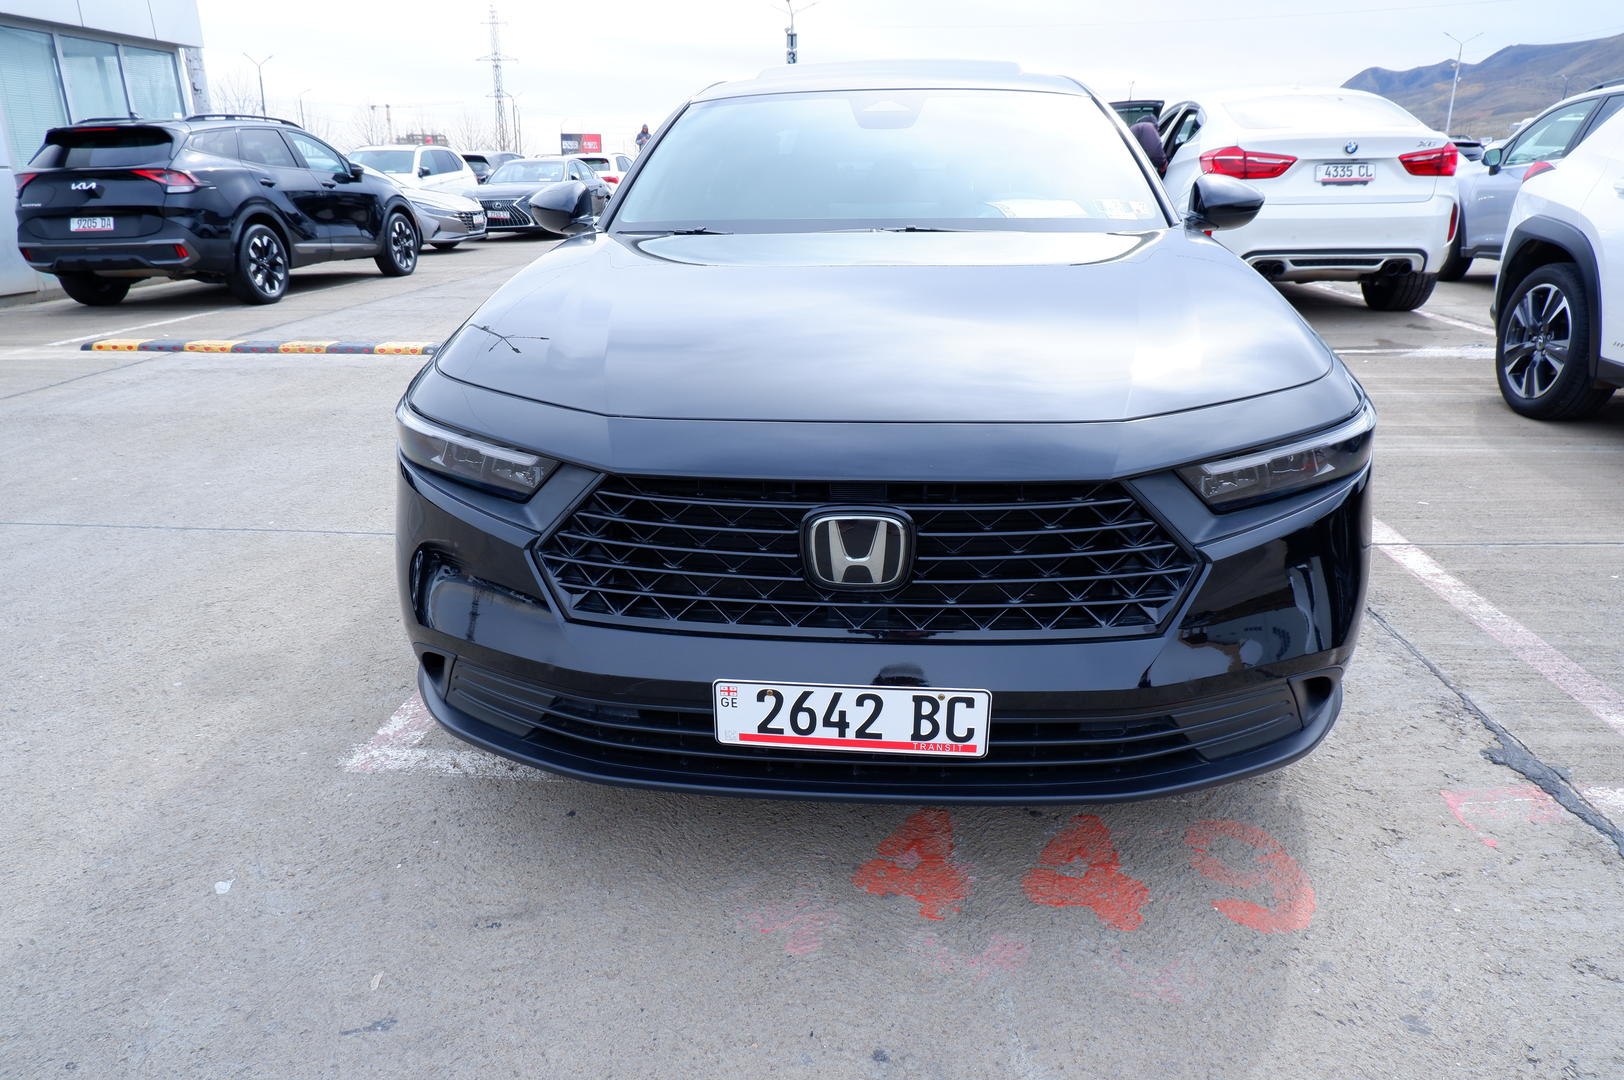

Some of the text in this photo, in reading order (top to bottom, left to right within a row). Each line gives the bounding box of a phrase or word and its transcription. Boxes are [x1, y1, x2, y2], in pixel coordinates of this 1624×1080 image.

[1325, 165, 1373, 178] 4335 CL
[77, 218, 97, 228] 9205
[720, 697, 738, 708] GE
[756, 689, 976, 743] 2642 BC
[912, 742, 964, 752] TRANSIT
